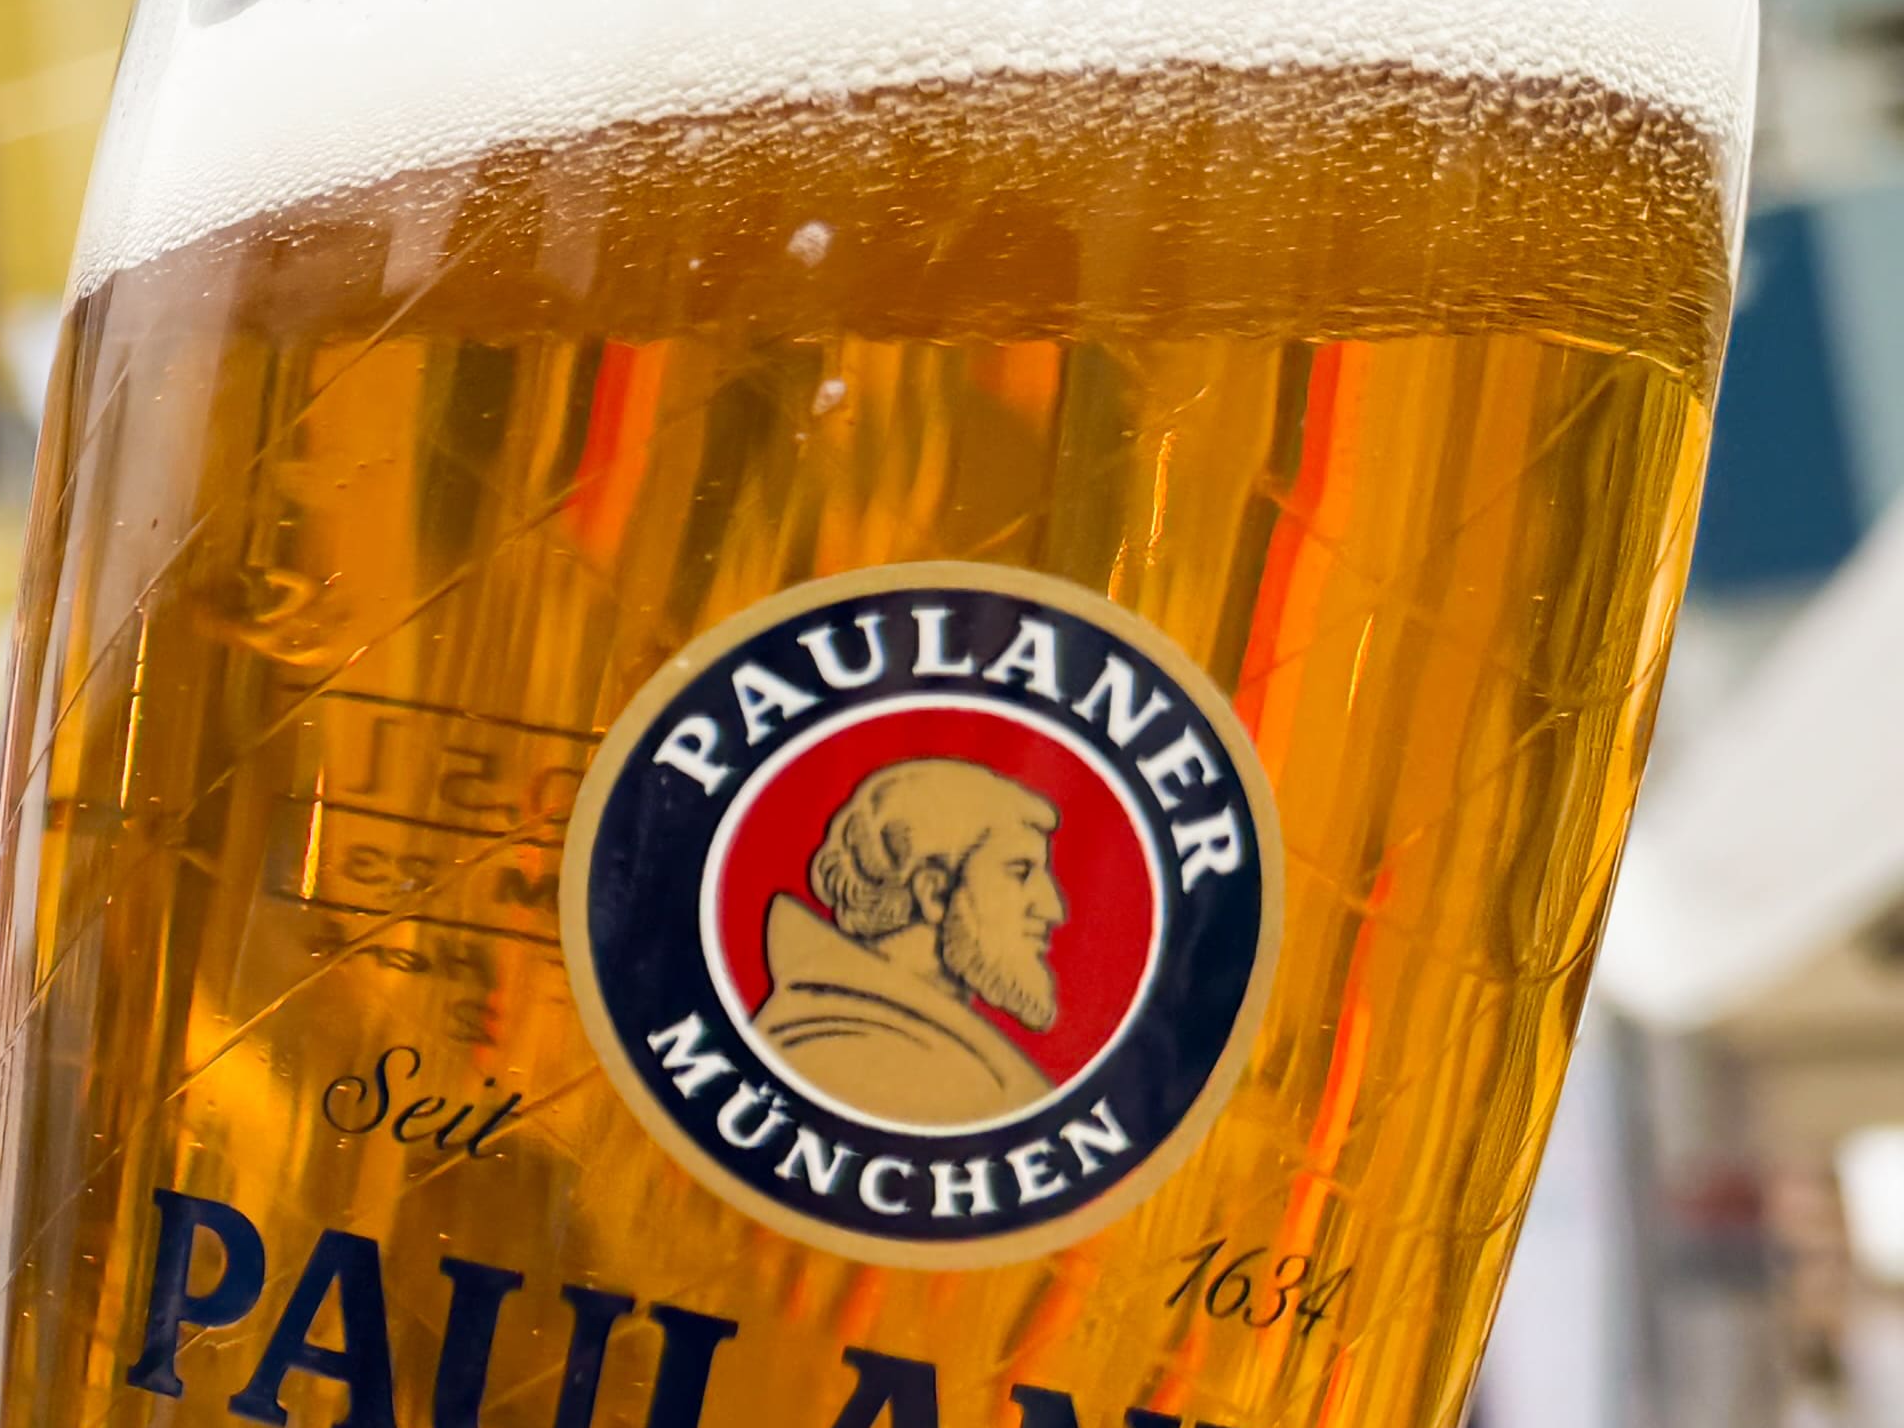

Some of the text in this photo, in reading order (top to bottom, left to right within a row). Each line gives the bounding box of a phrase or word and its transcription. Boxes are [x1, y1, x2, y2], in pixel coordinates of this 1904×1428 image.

[651, 605, 1245, 894] PAULANER
[322, 1045, 1350, 1336] Seit 1634
[645, 1012, 1133, 1220] MÜNCHEN
